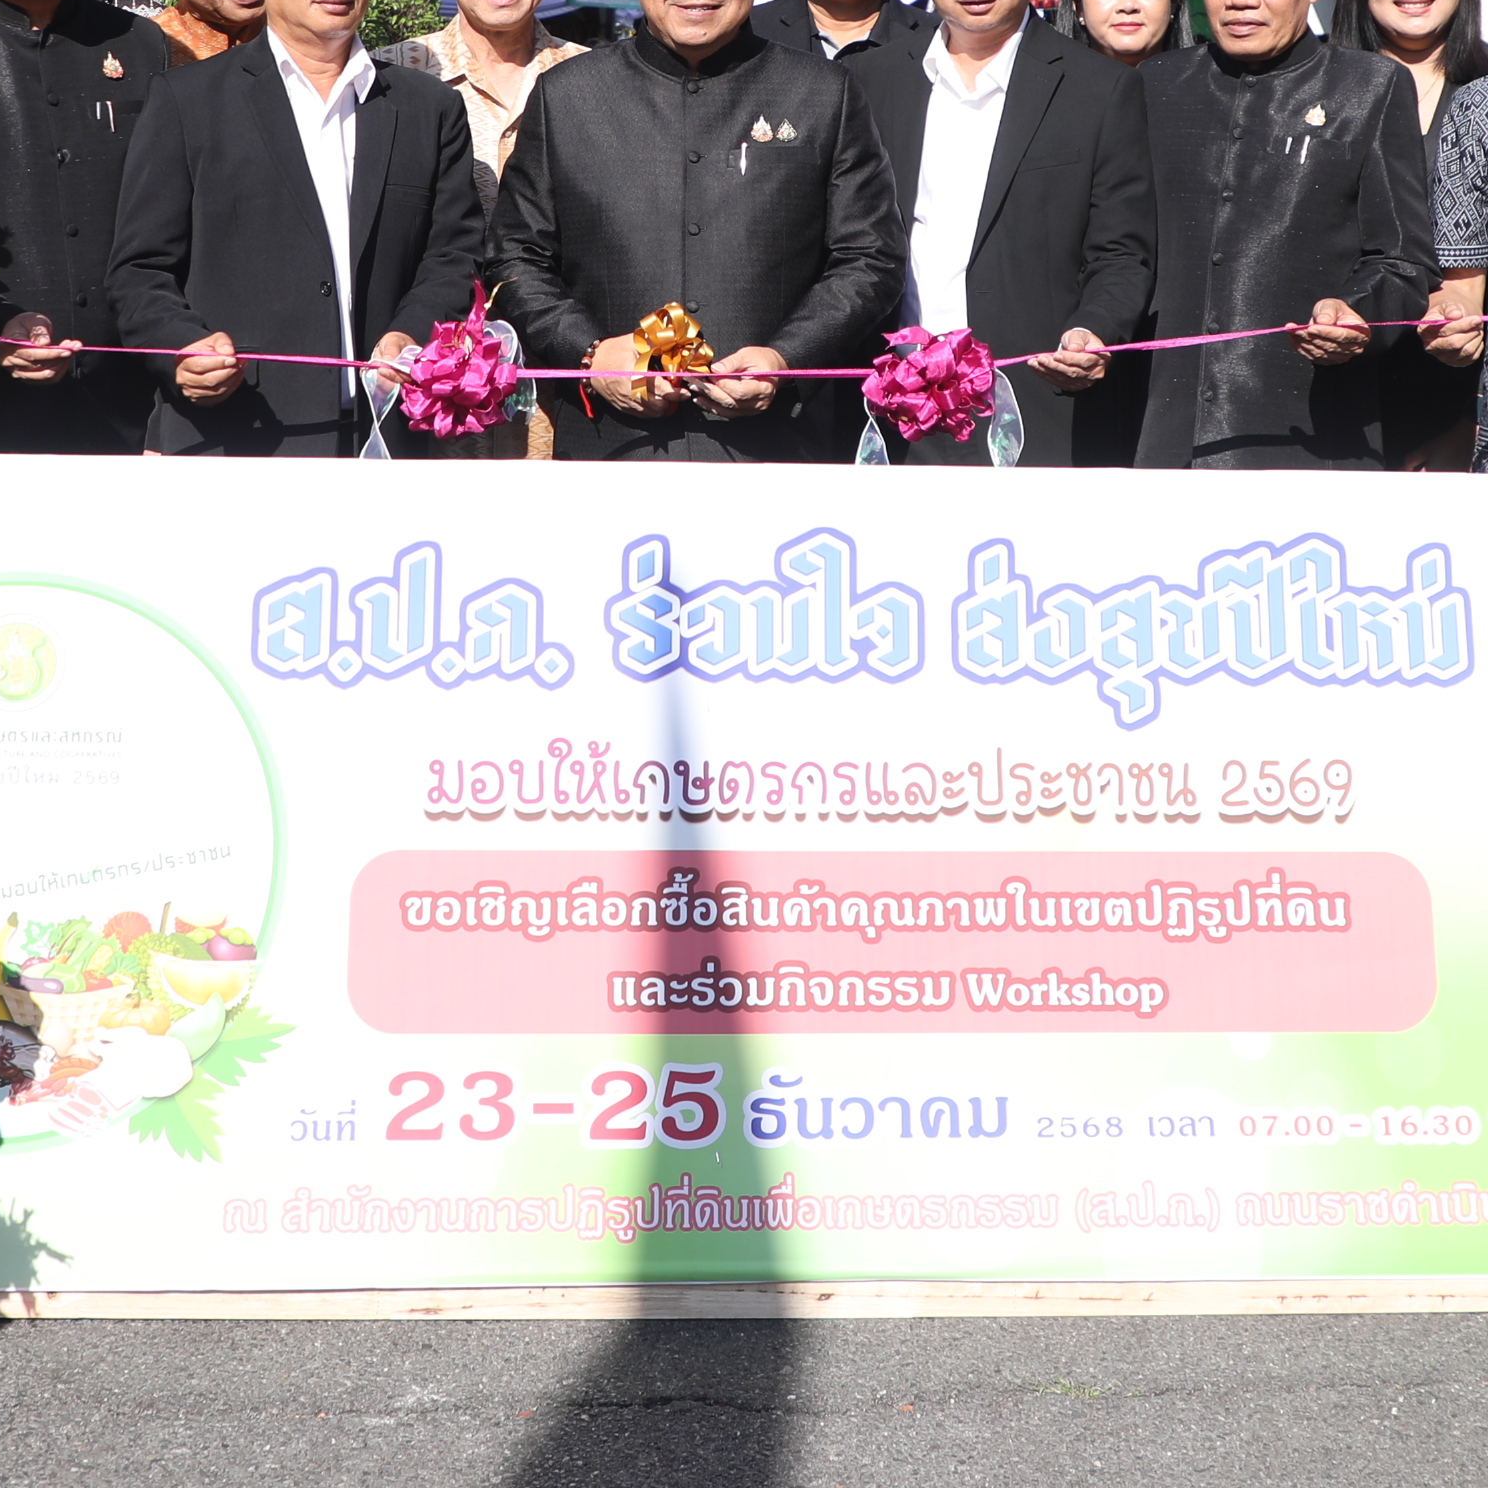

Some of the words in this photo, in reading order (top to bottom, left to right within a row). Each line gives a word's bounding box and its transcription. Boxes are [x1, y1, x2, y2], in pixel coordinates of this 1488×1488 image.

[253, 540, 574, 690] ส.ป.ก.
[605, 529, 924, 684] ร่วมใจ
[952, 534, 1474, 730] ส่งสุขปีใหม่
[53, 750, 122, 758] COOPERATIVES
[73, 770, 120, 784] 2569
[424, 738, 1199, 812] มอบให้เกษตรกรและประชาชน
[1221, 757, 1355, 815] 2569
[1, 843, 232, 899] มอบให้เกษตรกร/ประชาชน
[403, 869, 1348, 939] ขอเชิญเลือกซื้อสินค้าคุณภาพในเขตปฏิรูปที่ดิน
[612, 957, 951, 1011] และร่วมกิจกรรม
[965, 970, 1166, 1014] Workshop
[290, 1100, 356, 1142] วันที่
[384, 1069, 722, 1141] 23-25
[750, 1075, 1008, 1140] ธันวาคม
[1036, 1116, 1124, 1138] 2568
[1148, 1116, 1216, 1137] เวลา
[1239, 1115, 1334, 1137] 07.00
[1381, 1114, 1472, 1137] 16.30
[223, 1197, 274, 1234] ณ
[282, 1174, 1060, 1242] สำนักงานการปฏิรูปที่ดินเพื่อเกษตรกรรม
[1075, 1182, 1222, 1234] (ส.ป.ก.)
